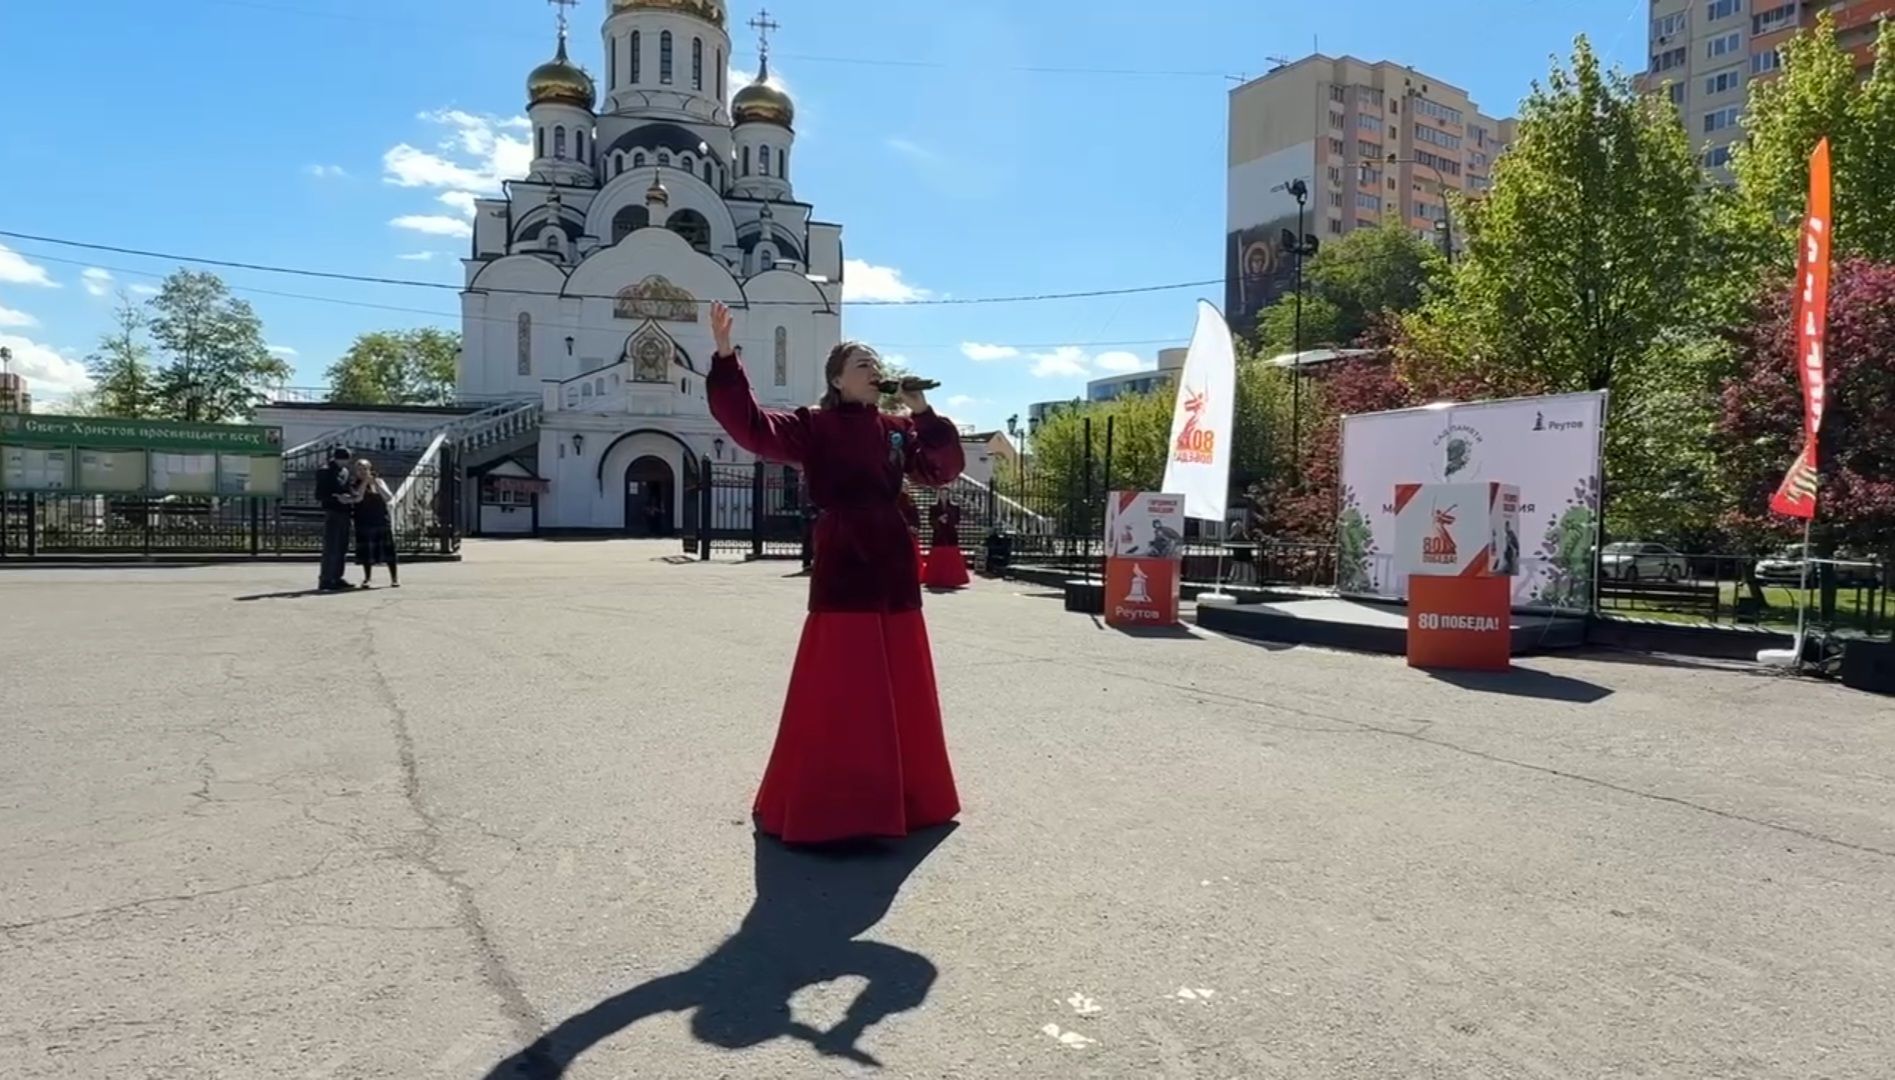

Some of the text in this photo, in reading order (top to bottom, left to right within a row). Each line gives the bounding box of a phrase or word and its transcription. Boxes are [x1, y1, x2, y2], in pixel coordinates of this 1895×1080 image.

[25, 420, 260, 444] Свет Христов просвещает всех
[1548, 420, 1584, 432] Реутов
[1115, 605, 1160, 620] Реутов
[1418, 612, 1500, 632] 80 ПОБЕДА!
